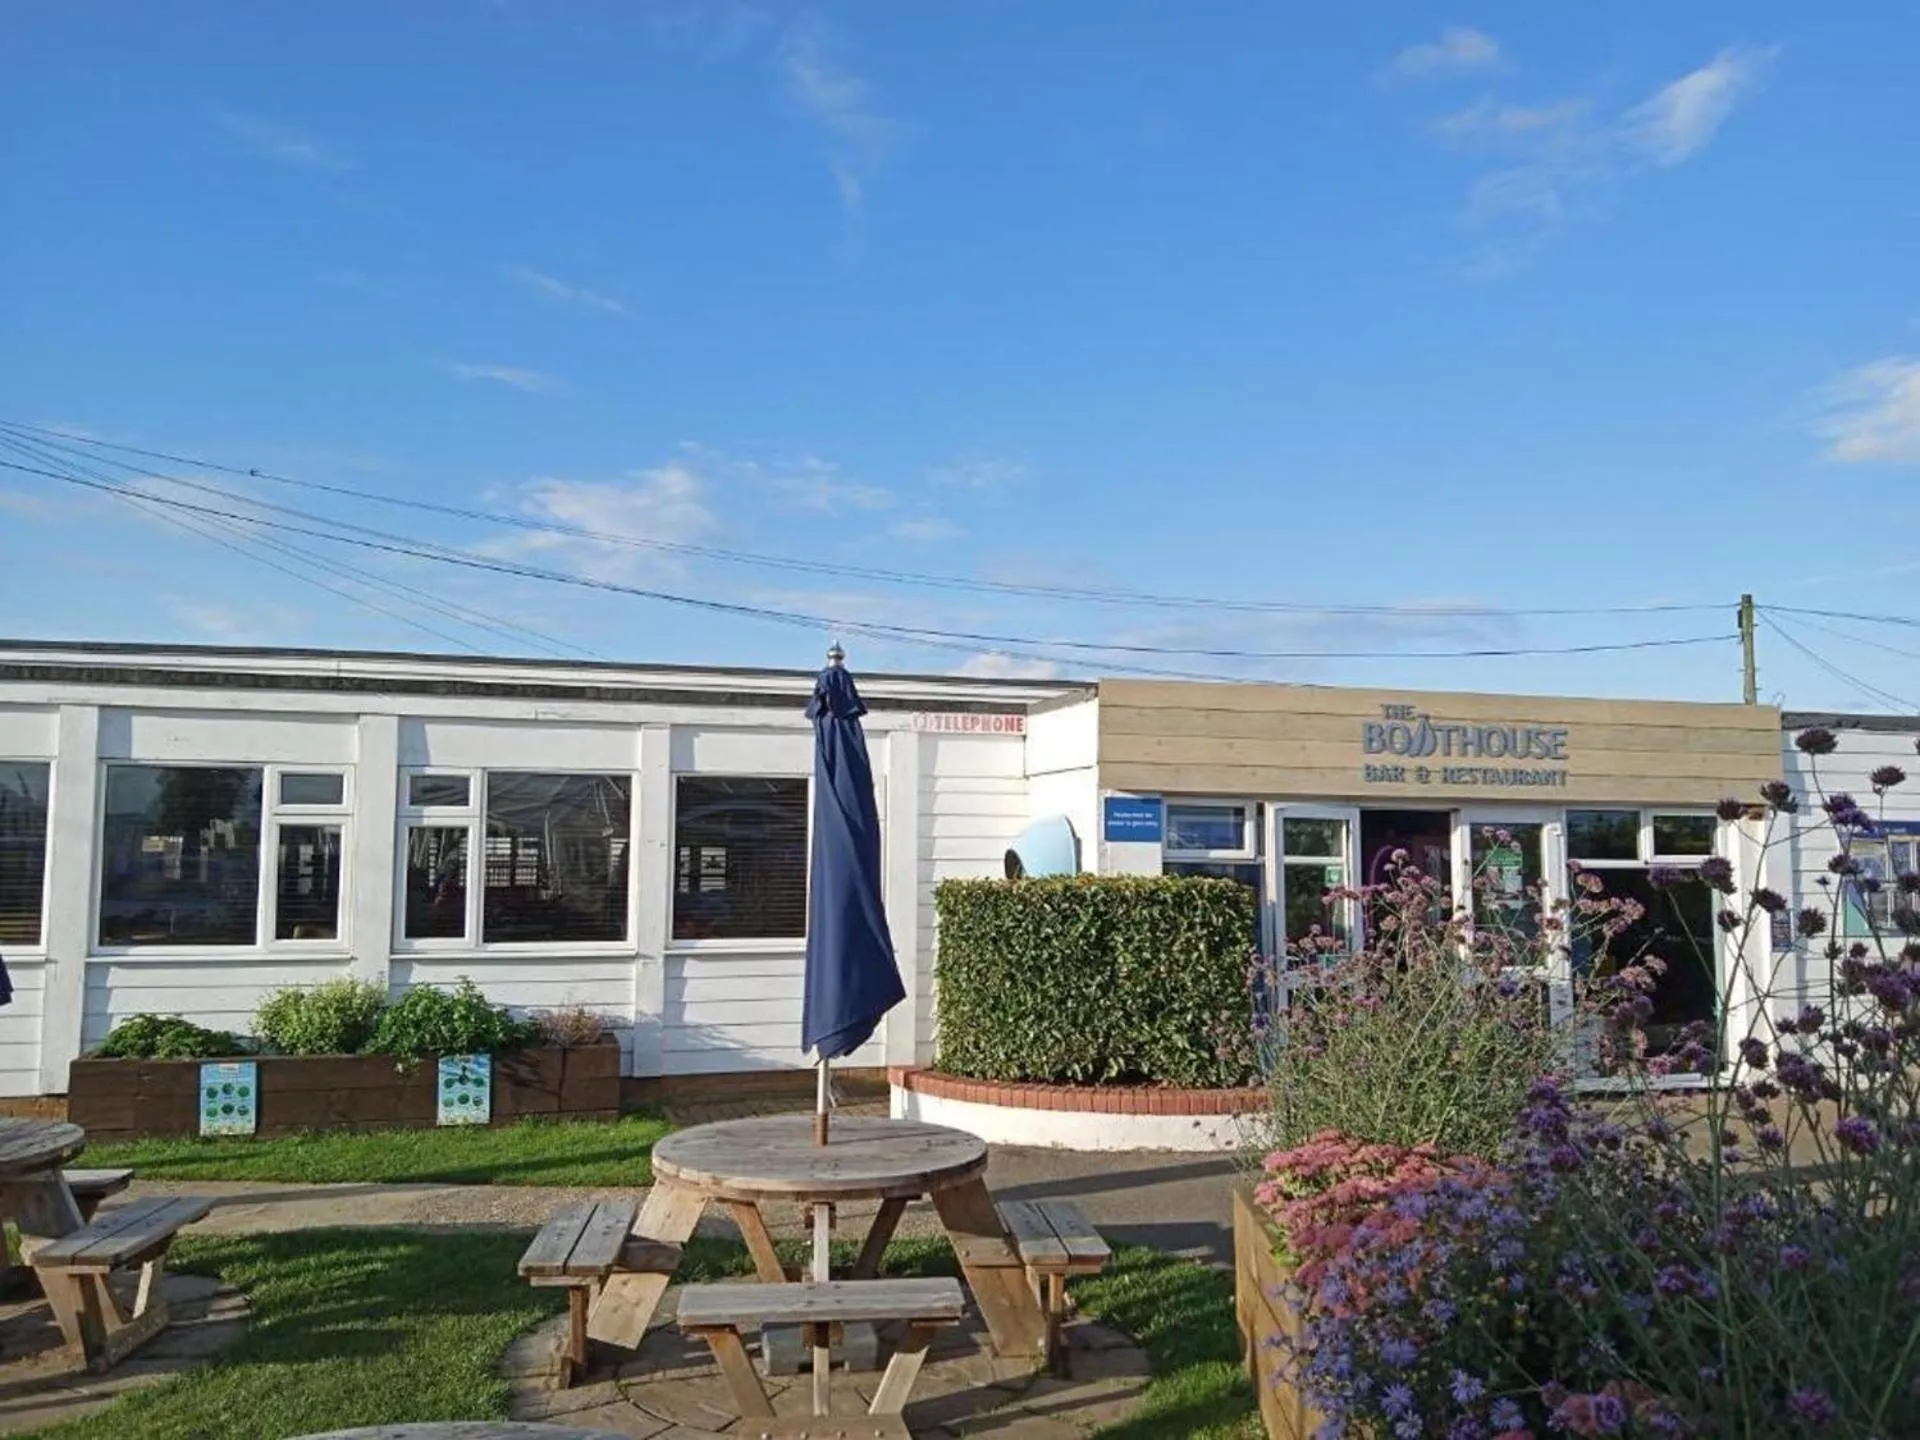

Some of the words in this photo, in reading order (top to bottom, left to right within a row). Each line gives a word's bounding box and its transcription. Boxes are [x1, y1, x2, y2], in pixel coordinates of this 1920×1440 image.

[1380, 703, 1417, 720] THE
[935, 715, 1024, 732] TELEPHONE
[1364, 764, 1405, 783] BAR
[1416, 766, 1430, 784] &
[1442, 766, 1569, 787] RESTAURANT
